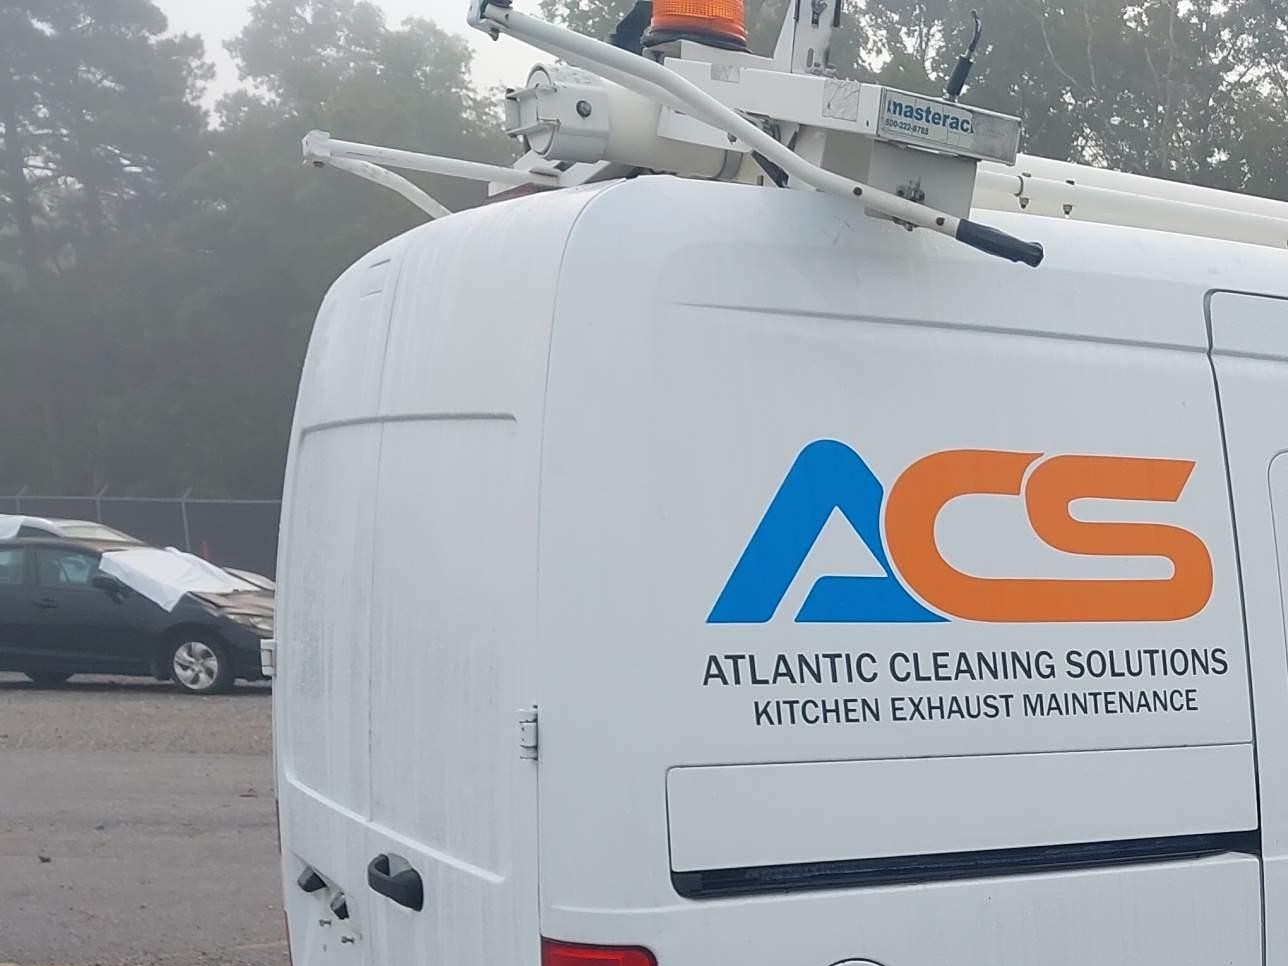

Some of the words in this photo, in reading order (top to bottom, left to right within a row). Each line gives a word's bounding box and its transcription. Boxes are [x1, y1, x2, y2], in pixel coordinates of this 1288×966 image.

[706, 439, 1214, 624] ACS
[703, 652, 879, 685] ATLANTIC
[889, 650, 1056, 682] CLEANING
[1066, 648, 1229, 678] SOLUTIONS
[753, 698, 881, 725] KITCHEN
[891, 694, 1014, 721] EXHAUST
[1023, 689, 1199, 717] MAINTENANCE
